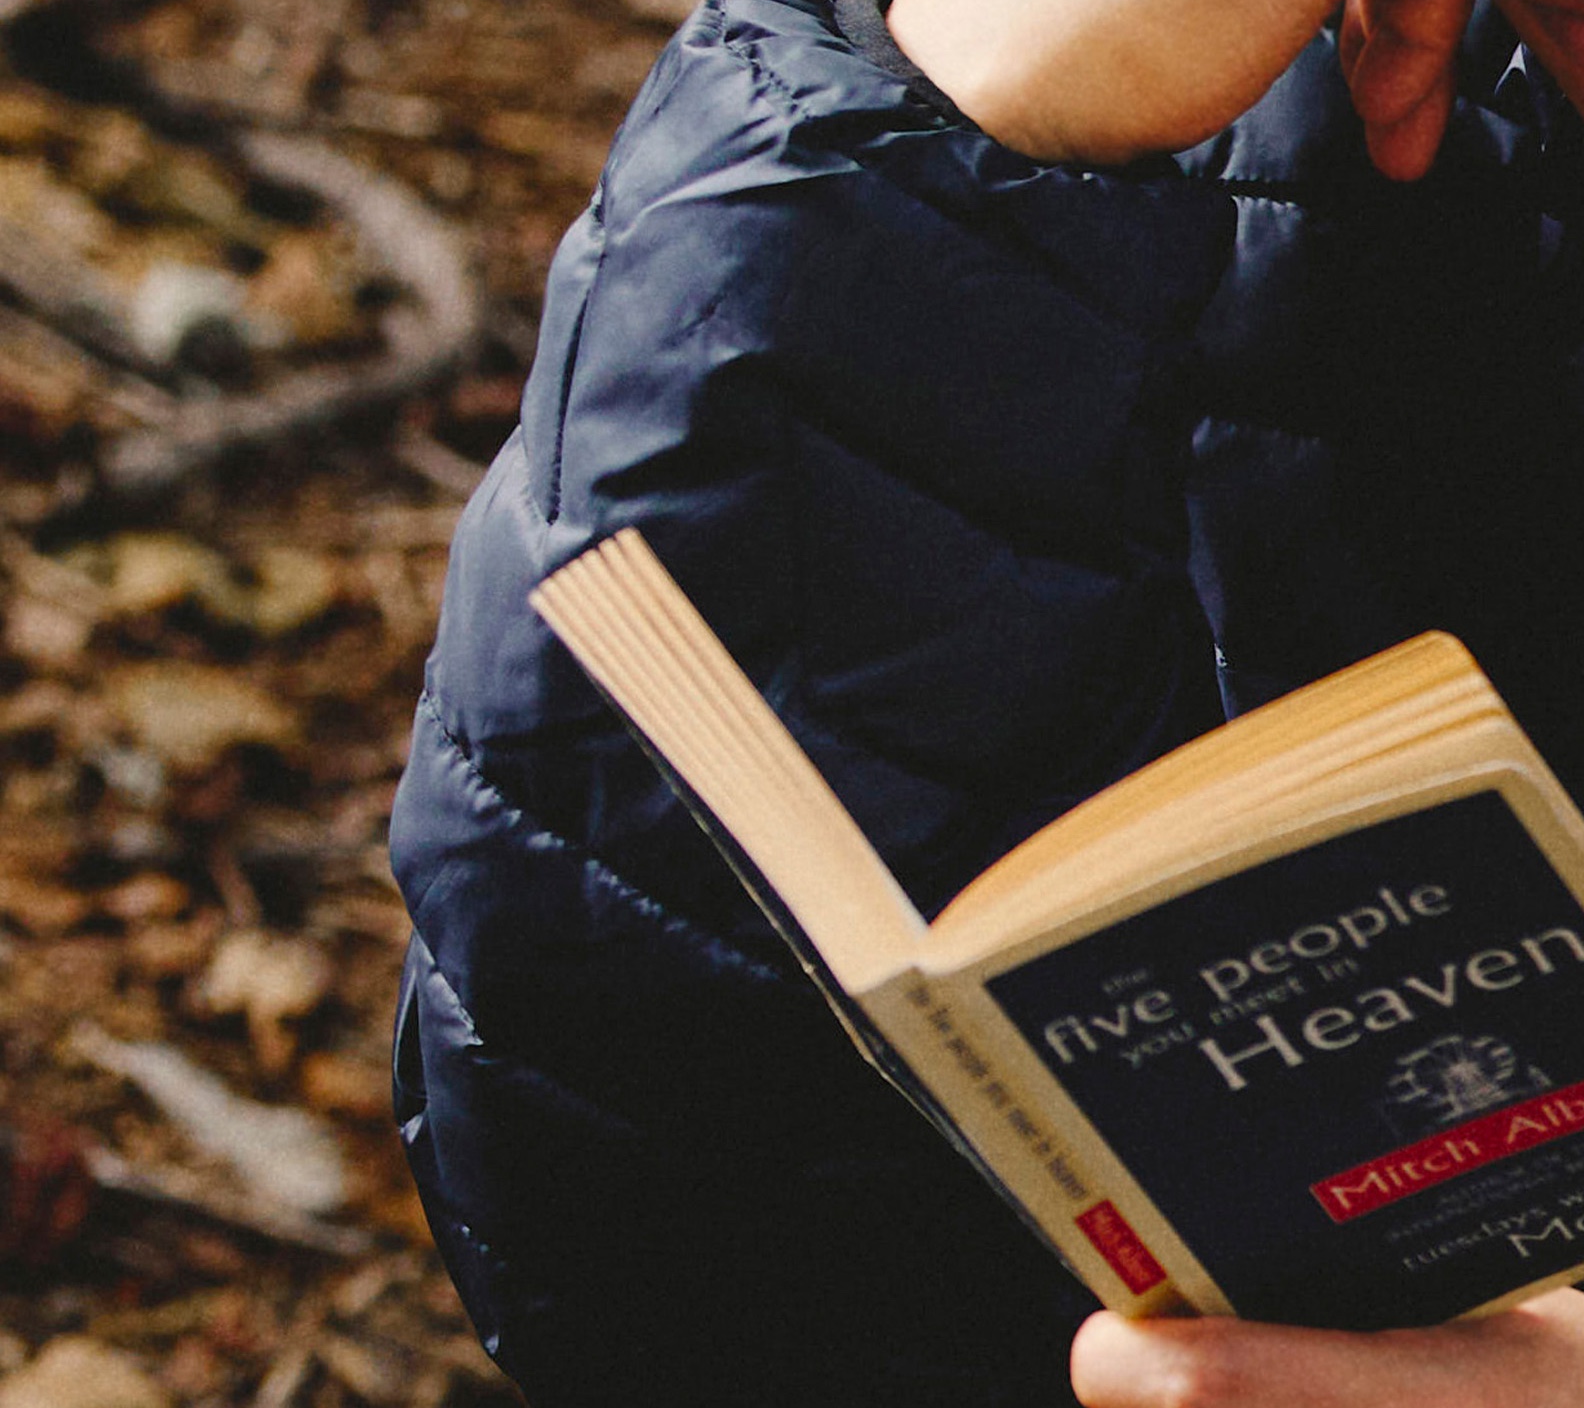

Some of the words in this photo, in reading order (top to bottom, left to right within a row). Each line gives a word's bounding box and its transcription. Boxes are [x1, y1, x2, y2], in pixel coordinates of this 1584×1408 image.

[1044, 989, 1176, 1065] five
[1199, 883, 1452, 1003] people
[1120, 1021, 1196, 1070] you
[1209, 975, 1305, 1026] meet
[1330, 1137, 1482, 1211] Mitch
